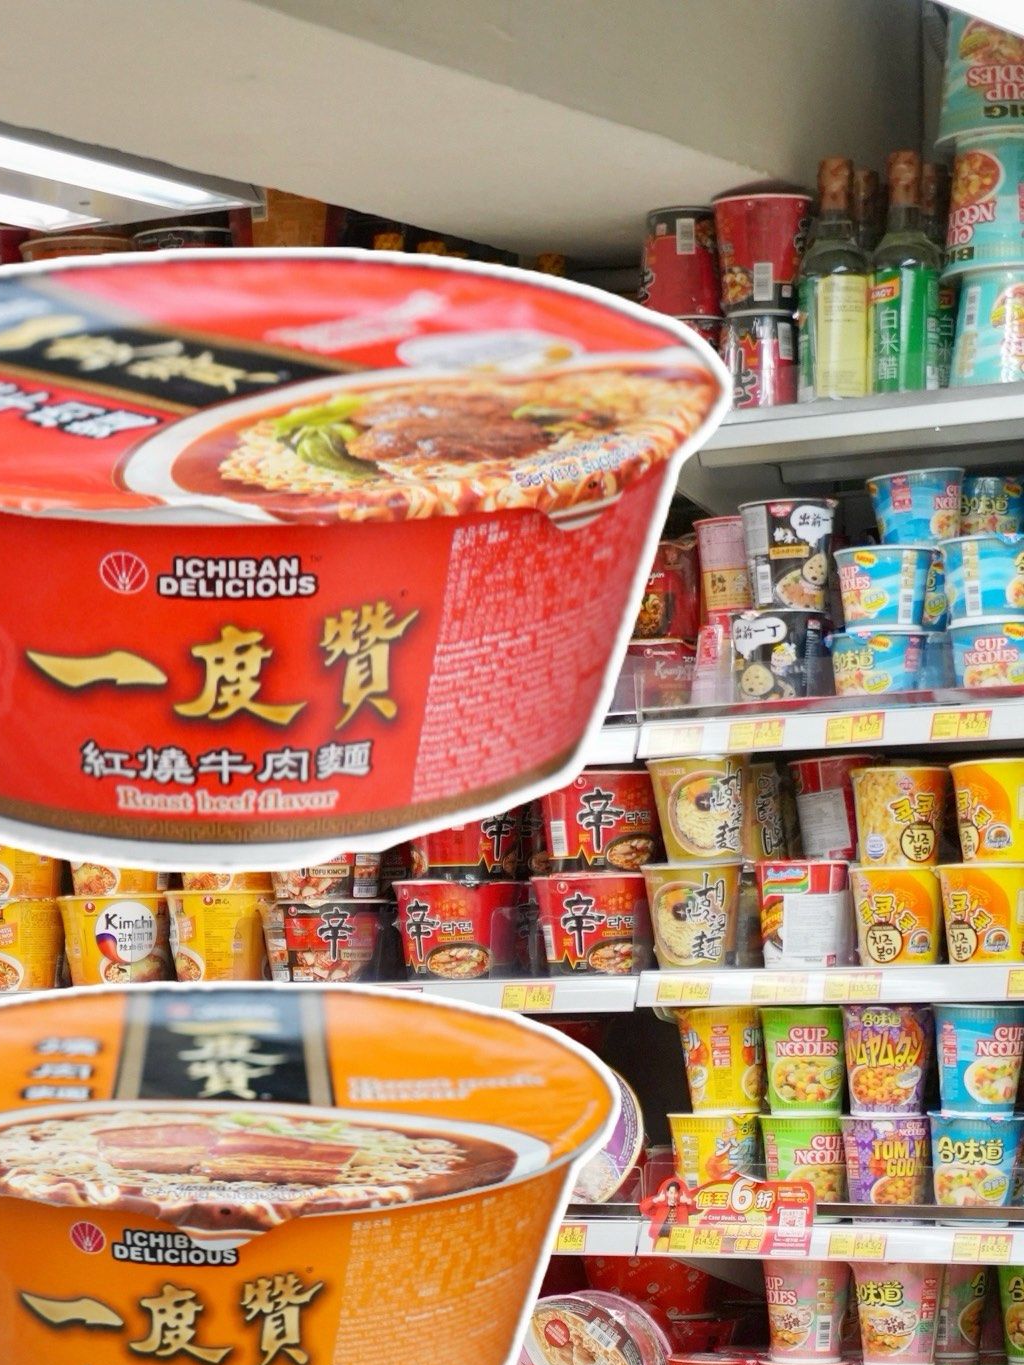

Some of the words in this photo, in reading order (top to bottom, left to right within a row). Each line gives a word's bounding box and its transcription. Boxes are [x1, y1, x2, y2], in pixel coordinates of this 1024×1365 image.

[175, 557, 299, 579] ICHIBAN
[159, 576, 316, 598] DELICIOUS
[975, 637, 1008, 651] CUP
[962, 650, 1019, 664] NOODLES
[117, 784, 187, 812] Roast
[195, 788, 254, 813] beef
[259, 787, 338, 812] flavor
[578, 788, 624, 852] 辛
[626, 809, 651, 824] 라면
[104, 912, 153, 931] Kimchi
[406, 901, 440, 960] 辛
[441, 921, 473, 935] 라면
[560, 894, 604, 956] 辛
[607, 915, 635, 929] 라면
[317, 908, 354, 962] 辛
[789, 1027, 829, 1042] CUP
[776, 1041, 838, 1056] NOODLES
[938, 1137, 1004, 1165] 合味道
[697, 1178, 775, 1212] 低至6折
[113, 1245, 237, 1265] DELICIOUS
